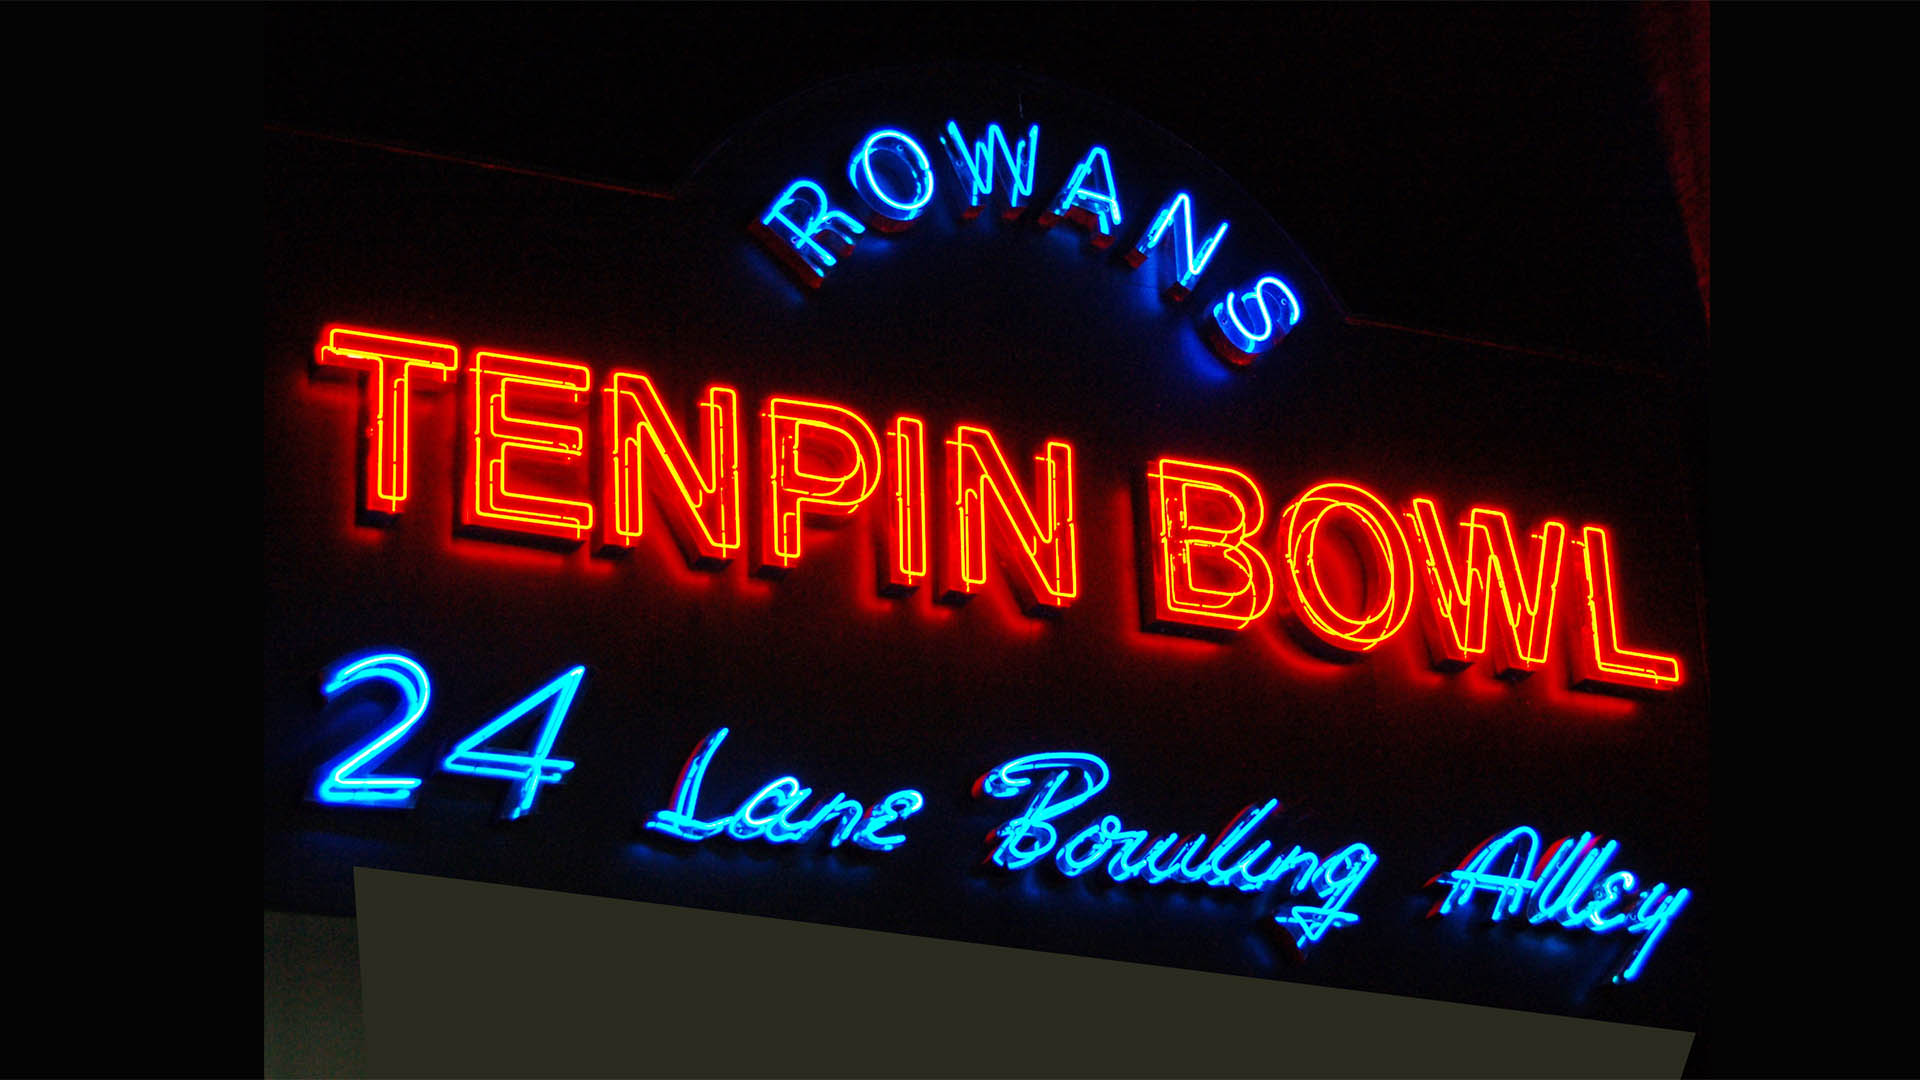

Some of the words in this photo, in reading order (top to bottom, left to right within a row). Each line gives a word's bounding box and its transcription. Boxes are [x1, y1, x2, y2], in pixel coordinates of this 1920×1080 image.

[758, 120, 1303, 360] ROWANS
[316, 325, 1080, 608] TENPIN
[1148, 456, 1683, 689] BOWL
[315, 651, 586, 819] 24
[646, 728, 925, 852] Lane
[982, 752, 1379, 949] Bowling
[1437, 826, 1692, 981] Alley
